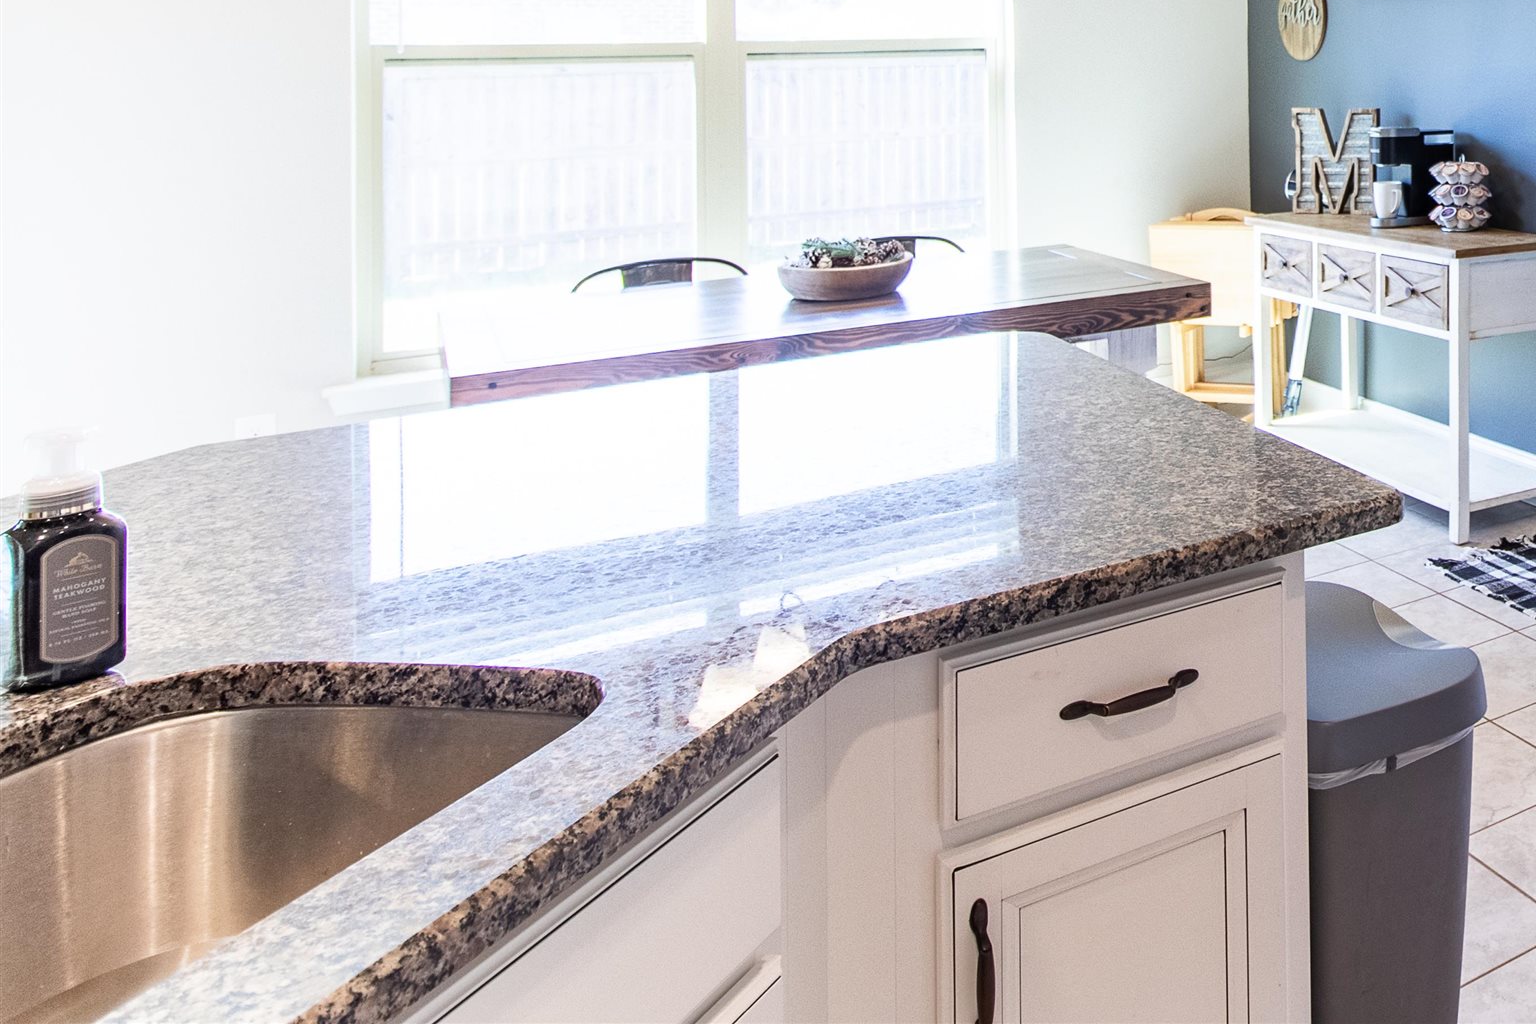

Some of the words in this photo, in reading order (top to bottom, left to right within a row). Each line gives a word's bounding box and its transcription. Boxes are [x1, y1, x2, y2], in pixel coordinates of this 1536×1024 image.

[1291, 107, 1380, 215] M
[52, 577, 107, 594] MAHOGANY
[53, 584, 106, 600] TEAKWOOD
